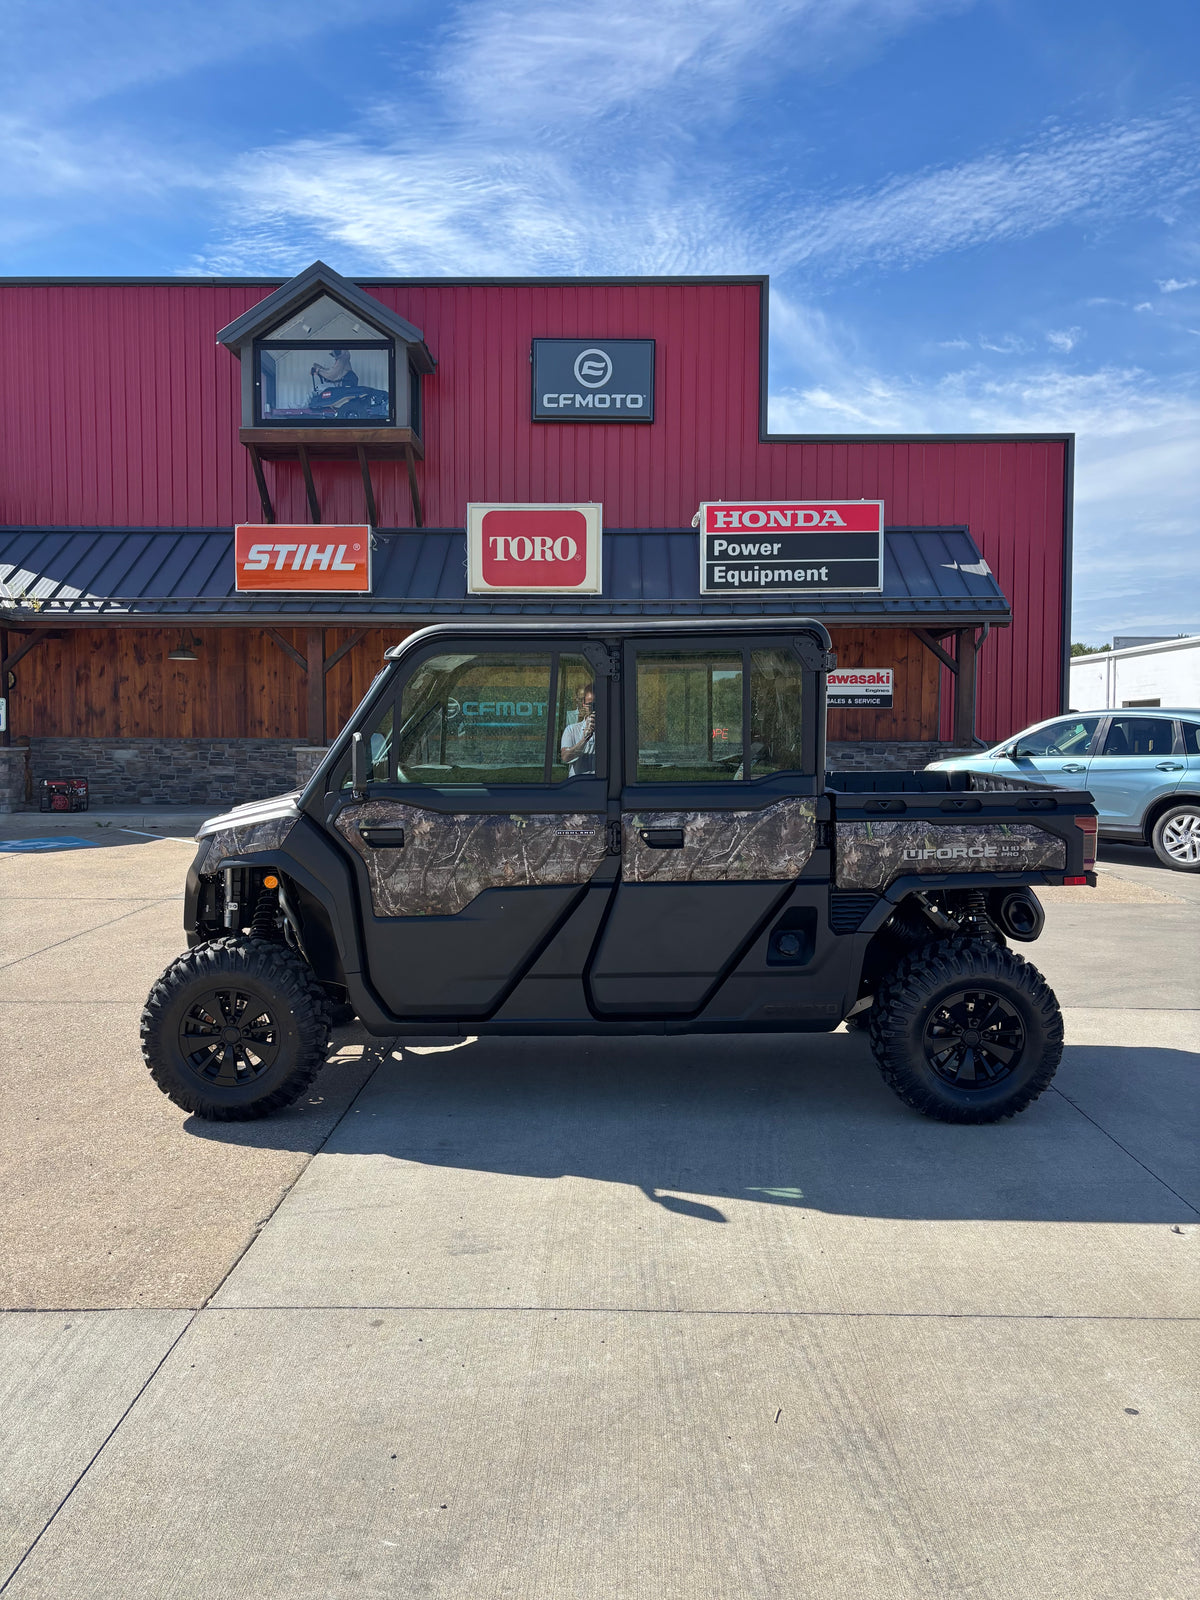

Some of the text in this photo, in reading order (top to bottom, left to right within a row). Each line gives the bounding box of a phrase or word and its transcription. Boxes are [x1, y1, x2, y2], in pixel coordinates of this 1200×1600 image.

[542, 393, 643, 409] CFMOTO
[713, 509, 847, 528] HONDA
[488, 536, 578, 562] TORO
[713, 539, 782, 556] Power
[243, 544, 357, 571] STIHL
[713, 566, 829, 586] Equipment
[827, 672, 890, 685] awasaki
[462, 701, 559, 717] CFMOT
